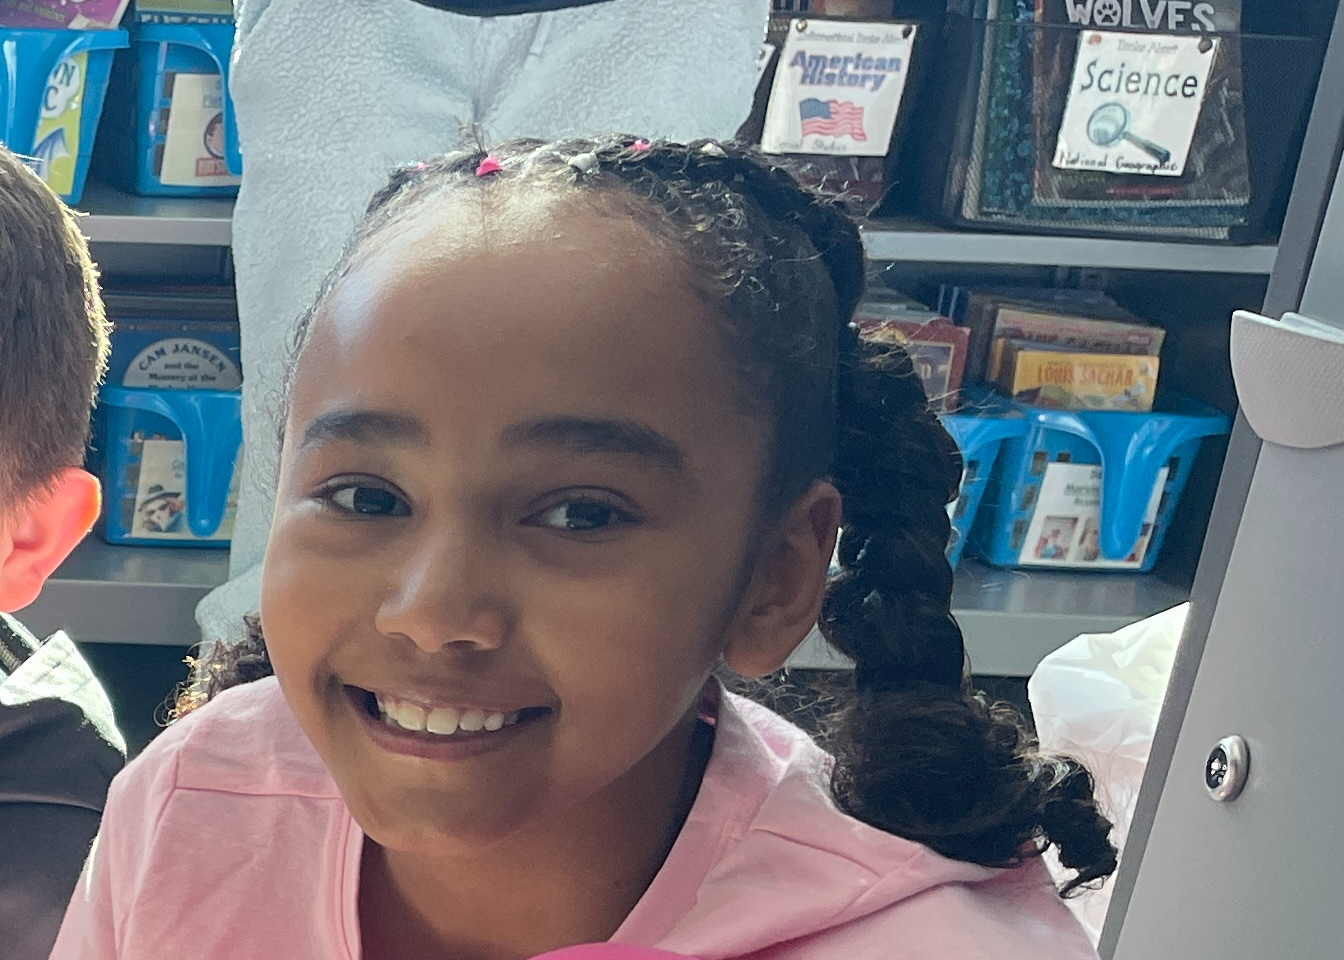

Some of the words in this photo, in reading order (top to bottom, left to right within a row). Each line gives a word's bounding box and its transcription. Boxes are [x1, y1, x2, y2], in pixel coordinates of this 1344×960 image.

[789, 49, 903, 73] American
[799, 65, 887, 93] History
[1079, 57, 1199, 98] Science
[1060, 150, 1109, 168] National
[138, 345, 168, 372] CAM
[172, 343, 227, 373] JANSEN
